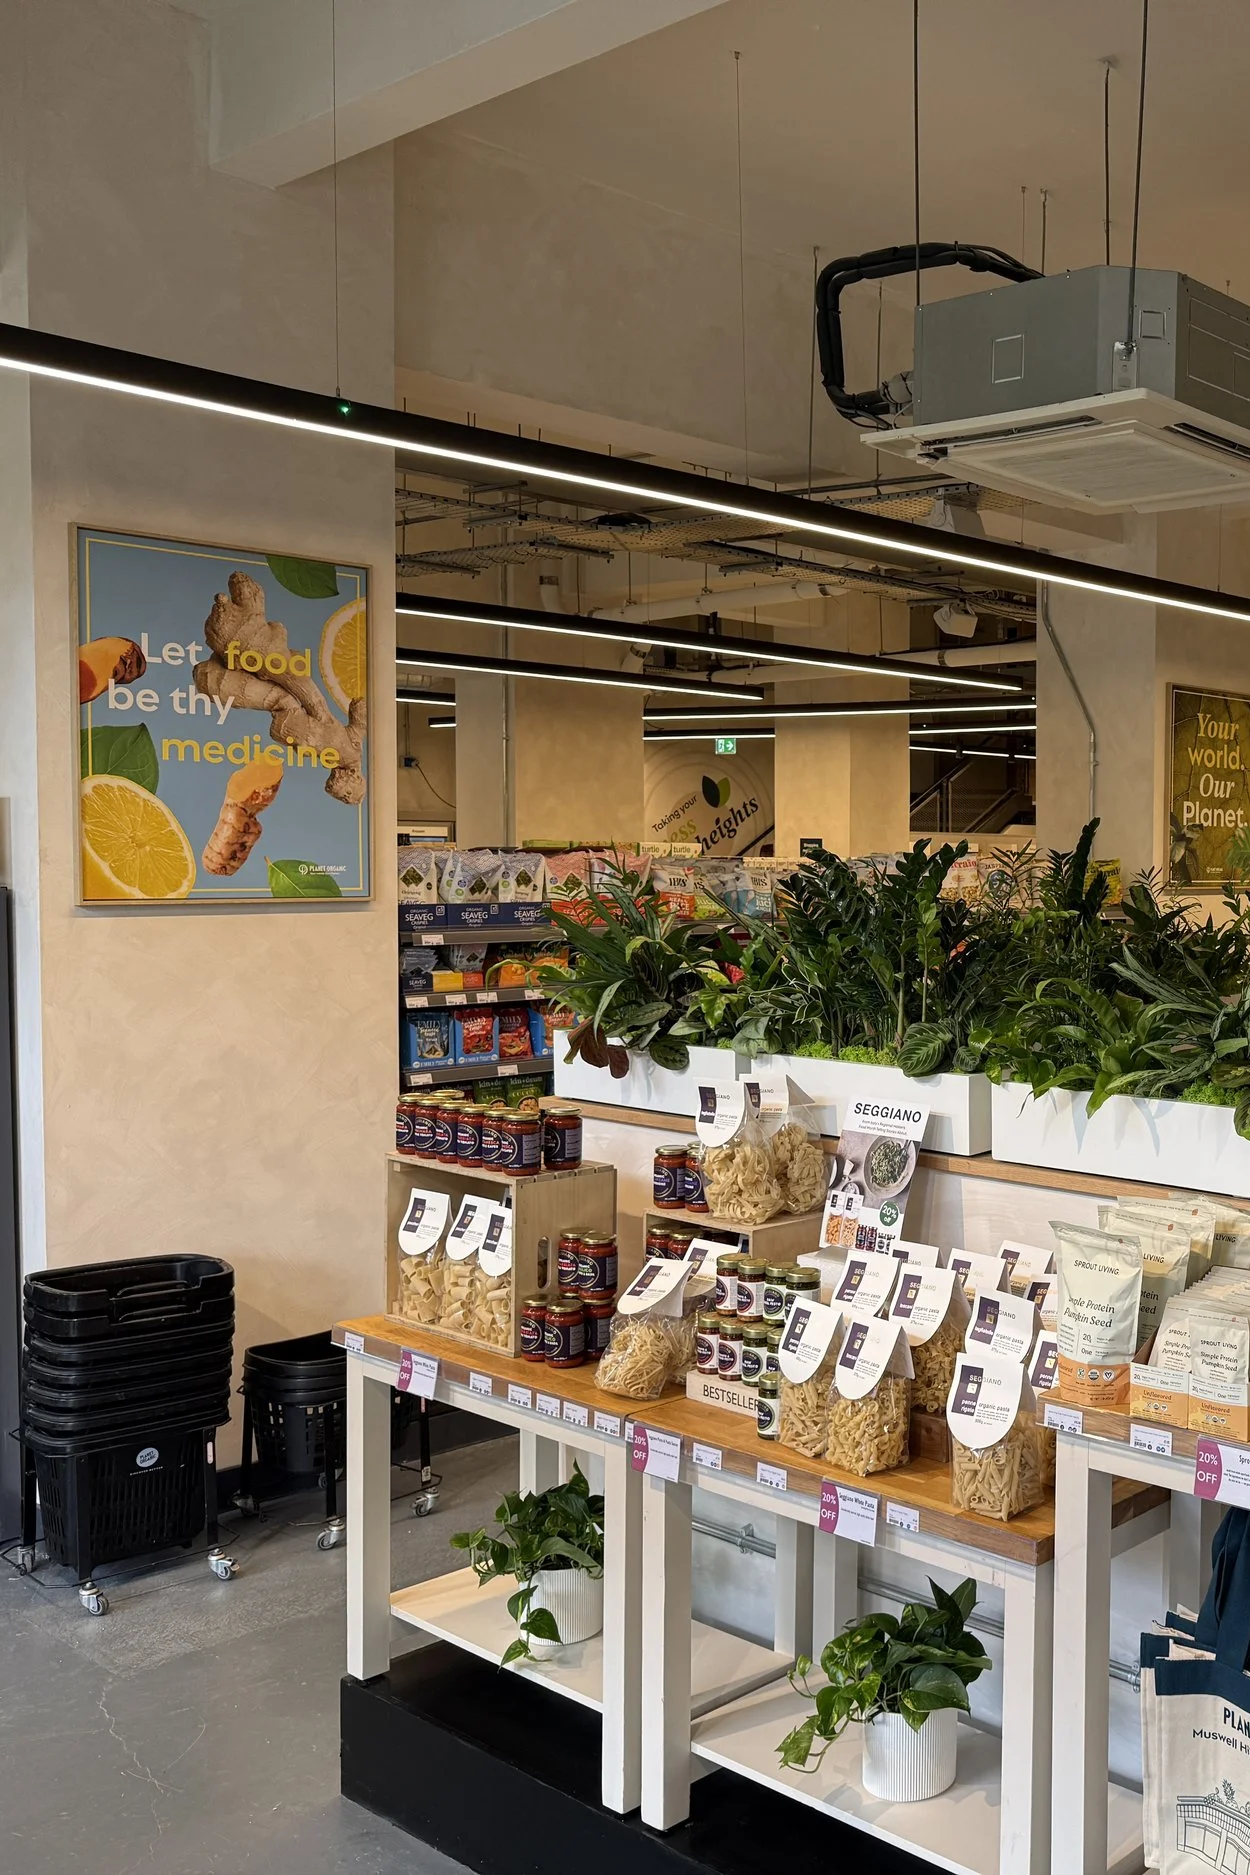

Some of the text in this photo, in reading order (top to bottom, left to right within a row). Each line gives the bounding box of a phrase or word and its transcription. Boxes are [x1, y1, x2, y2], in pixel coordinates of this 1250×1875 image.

[141, 632, 311, 677] Let food
[107, 679, 234, 725] be thy
[1198, 713, 1239, 740] Your
[162, 736, 340, 768] medicine
[1188, 745, 1245, 771] world.
[1200, 773, 1235, 798] Our
[652, 795, 697, 833] Taking your
[1183, 801, 1248, 828] Planet.
[695, 797, 759, 854] heights
[854, 1103, 922, 1123] SEGGIANO
[882, 1206, 897, 1219] 20%
[1074, 1260, 1097, 1271] SPROUT
[1086, 1300, 1115, 1313] Protein
[987, 1306, 1016, 1320] SEGGIANO
[1063, 1310, 1112, 1328] Pumpkin Seed
[995, 1333, 1024, 1345] organic pasta
[1169, 1329, 1187, 1337] SPROUT
[1201, 1339, 1219, 1348] SPROUT
[1081, 1348, 1092, 1356] One
[1162, 1348, 1183, 1357] Pumpkin
[1201, 1352, 1238, 1364] Simple Protein
[402, 1359, 411, 1368] 20%
[1202, 1359, 1238, 1372] Pumpkin Seed
[400, 1372, 410, 1380] OFF
[969, 1375, 1002, 1386] SEGGIANO
[1143, 1390, 1171, 1400] Unflavored
[979, 1402, 1010, 1413] organic pasta
[1201, 1402, 1230, 1413] Unflavored
[634, 1435, 646, 1446] 20%
[140, 1450, 154, 1459] PLANET
[634, 1450, 646, 1460] OFF
[1199, 1452, 1218, 1466] 20%
[1197, 1471, 1217, 1484] OFF
[822, 1492, 836, 1504] 20%
[821, 1509, 836, 1520] OFF
[1192, 1728, 1237, 1749] Muswell
